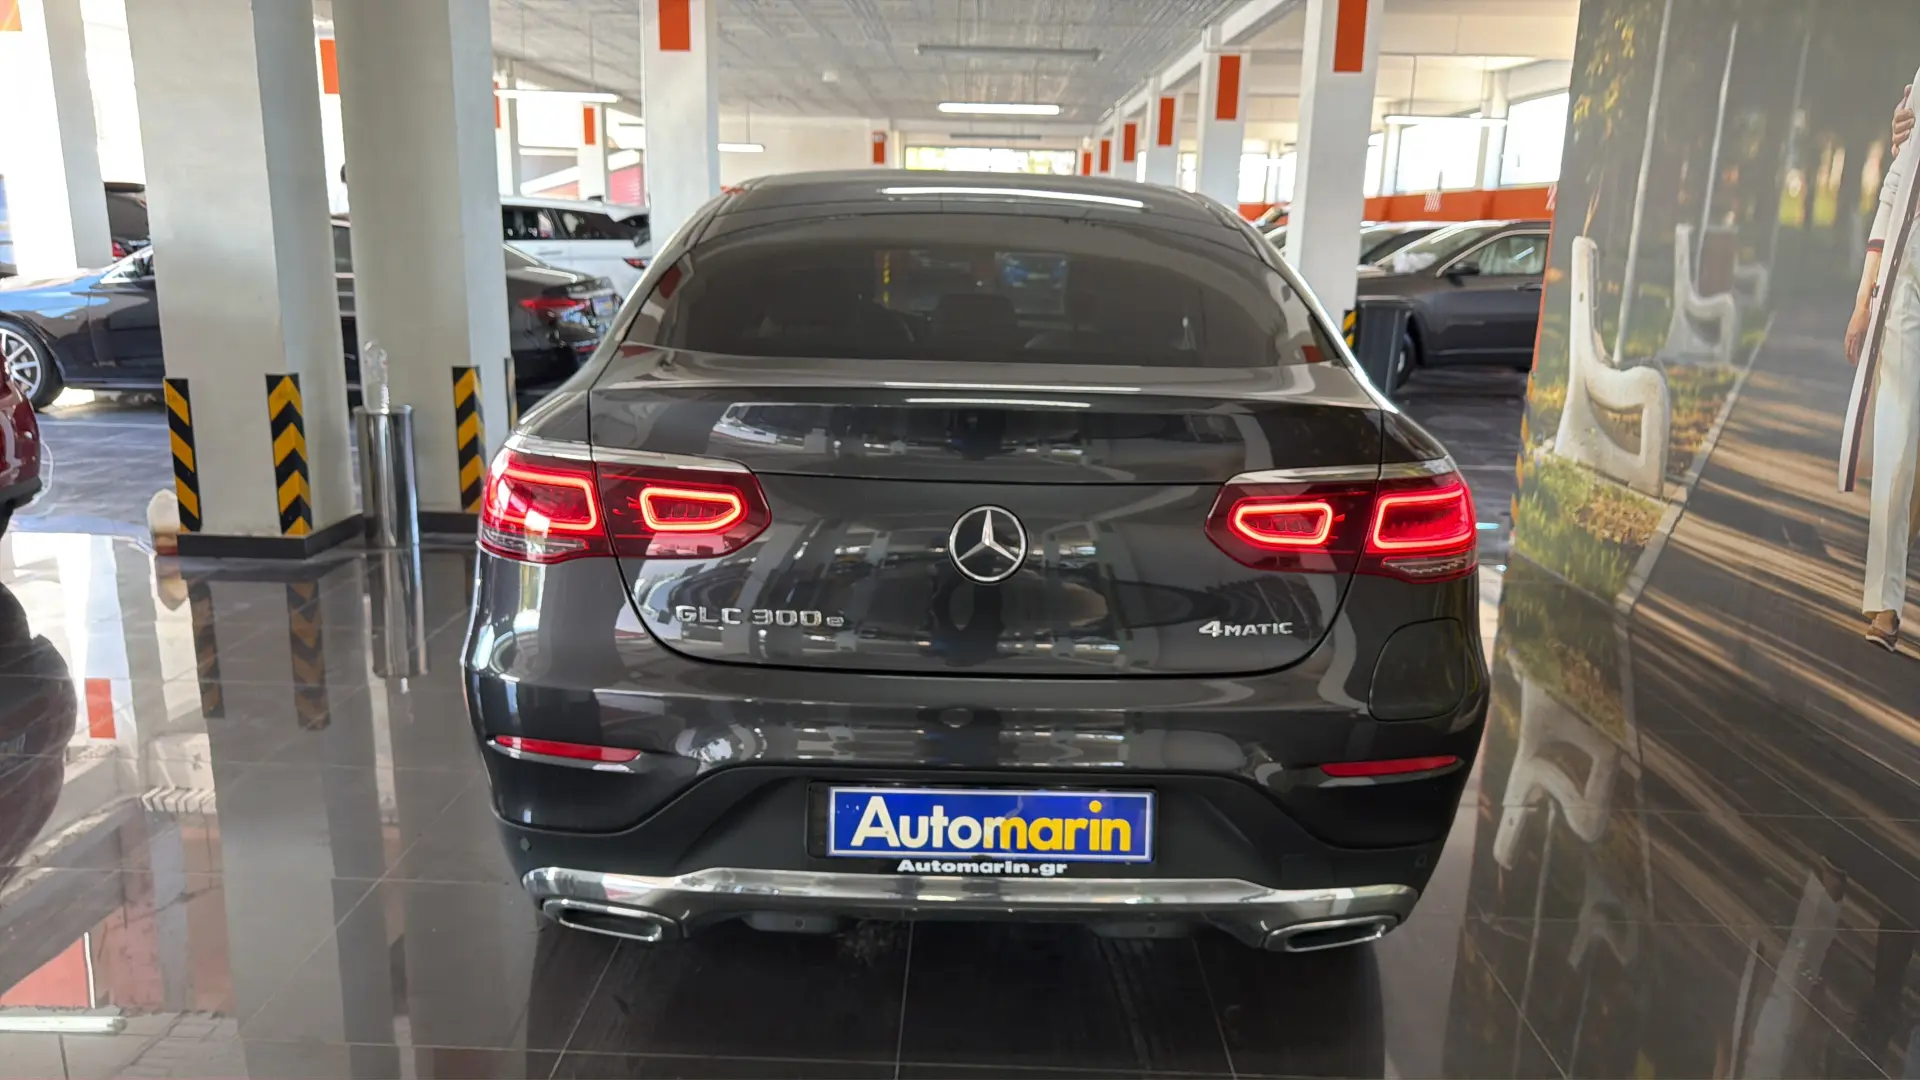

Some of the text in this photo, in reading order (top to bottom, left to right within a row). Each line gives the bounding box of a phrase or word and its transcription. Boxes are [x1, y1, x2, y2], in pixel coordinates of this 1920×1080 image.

[675, 605, 742, 624] GLC
[1199, 620, 1293, 637] 4MATIC
[850, 795, 1132, 851] Automarin
[897, 859, 1068, 876] Automarin.gr
